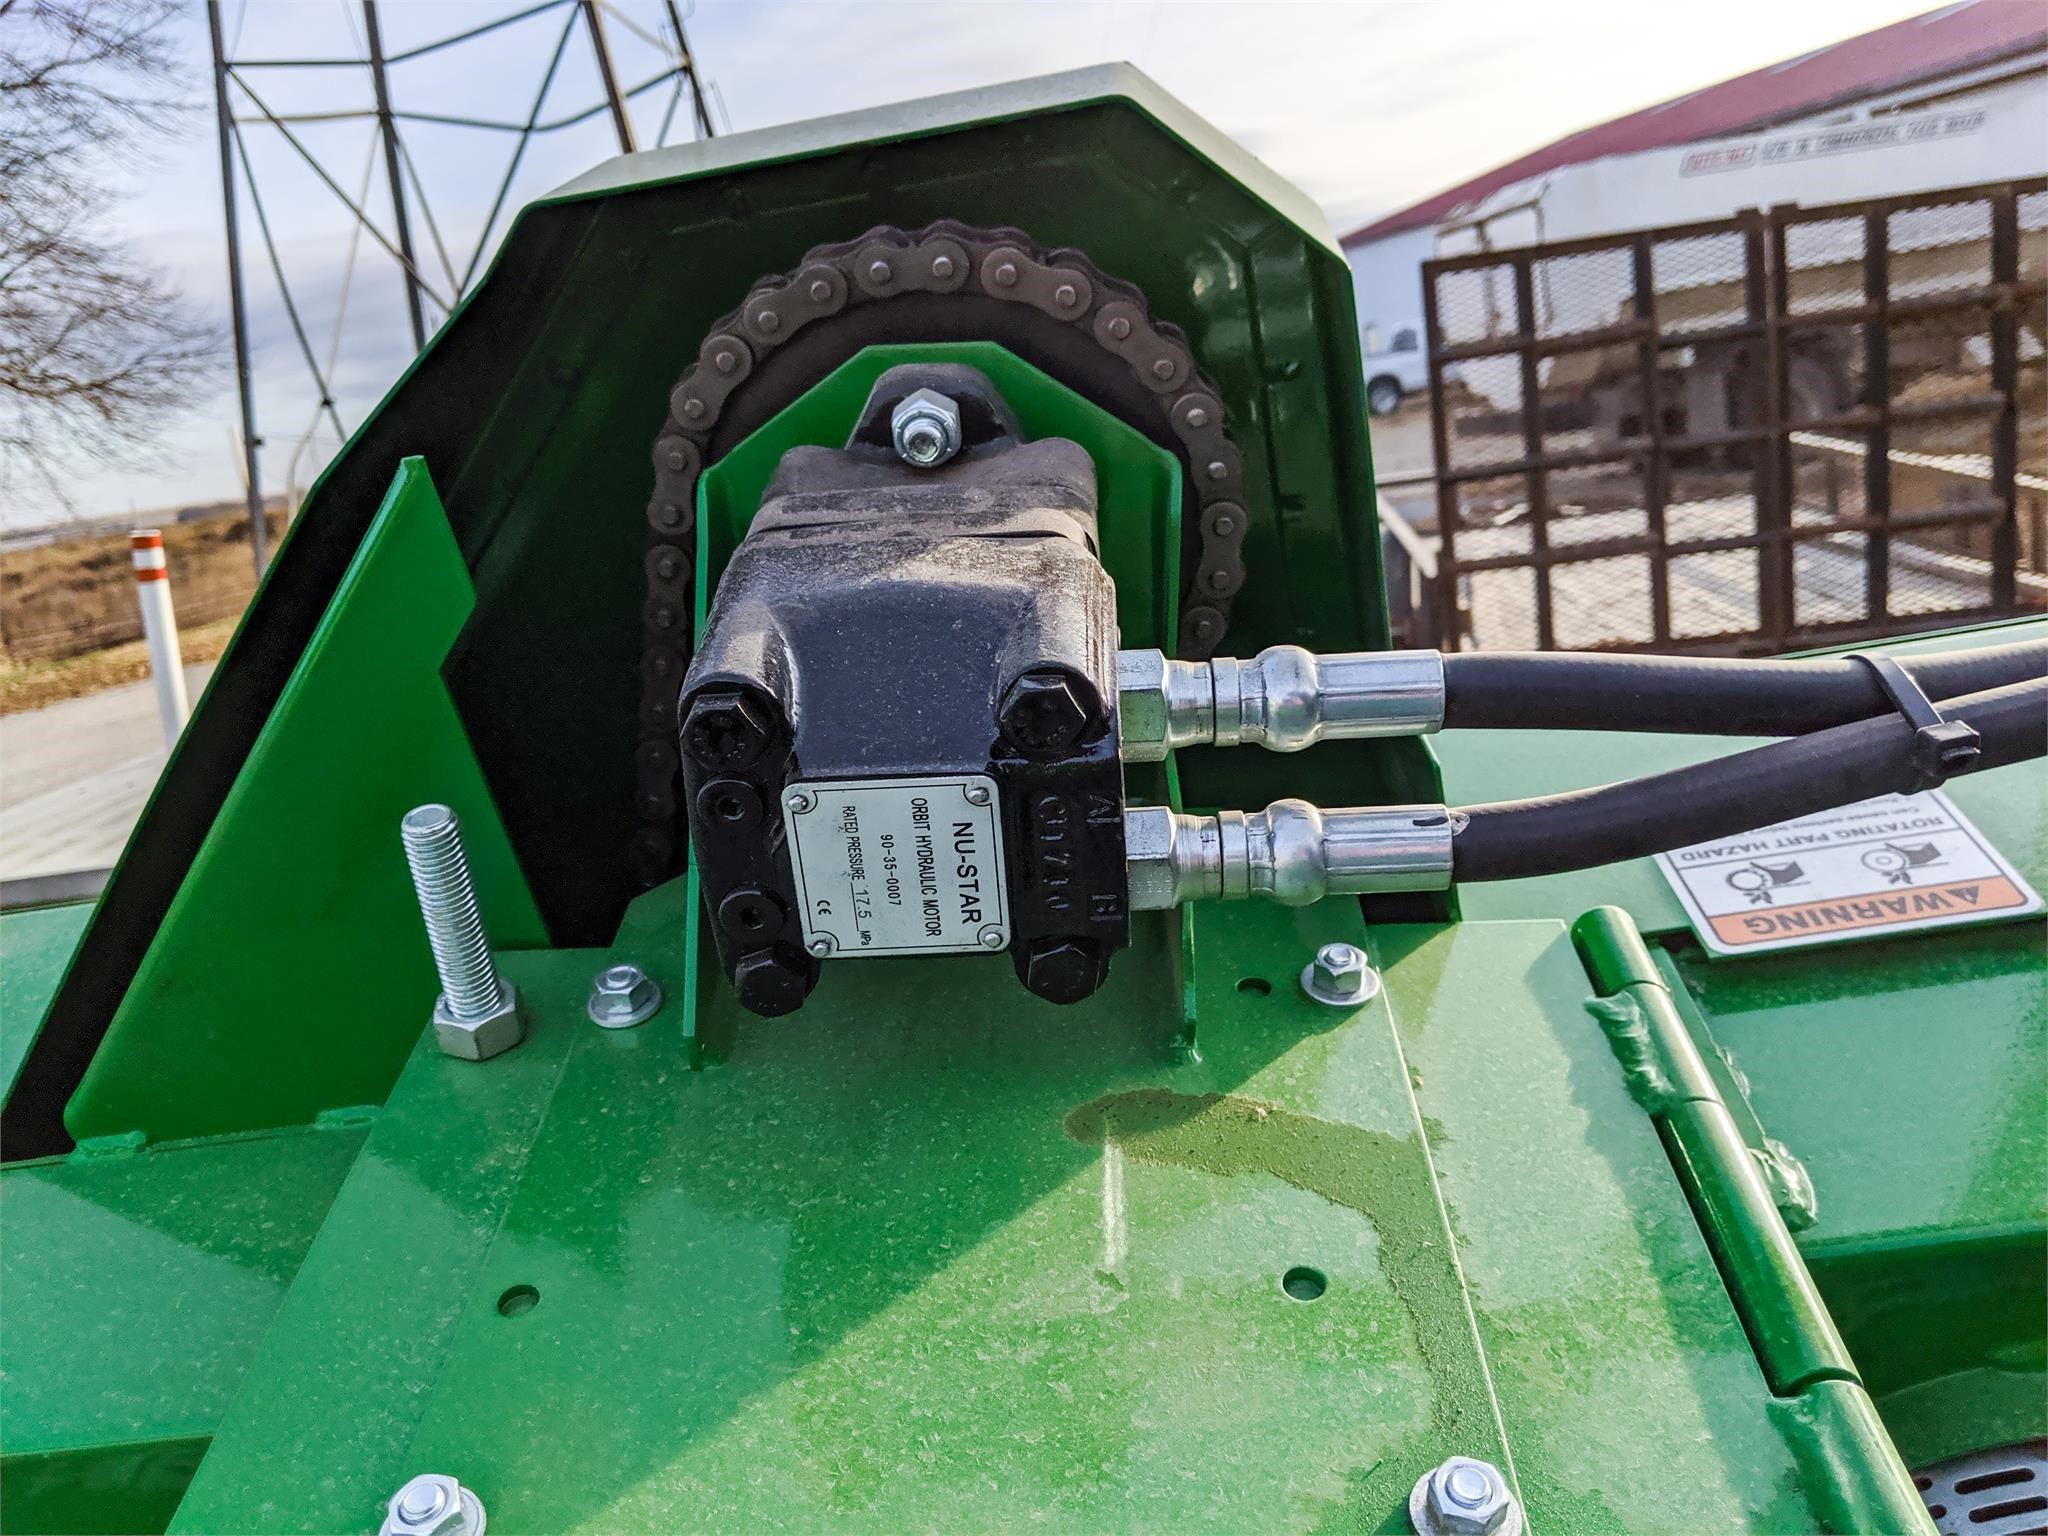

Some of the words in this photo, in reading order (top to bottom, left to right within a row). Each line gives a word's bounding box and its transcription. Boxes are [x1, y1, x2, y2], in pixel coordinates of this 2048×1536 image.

[842, 805, 859, 834] RATED
[911, 797, 931, 831] ORBIT
[1831, 816, 1944, 839] ROTATING
[1680, 841, 1768, 862] HAZARD
[1775, 833, 1830, 848] PART
[846, 836, 865, 881] PRESSURE
[880, 834, 902, 906] 90-35-0007
[915, 835, 938, 895] HYDRAULIC
[952, 822, 982, 925] NU-STAR
[855, 888, 872, 919] 17.5
[922, 899, 942, 937] MOTOR
[1743, 892, 1954, 935] WARNING
[859, 930, 872, 946] MPa
